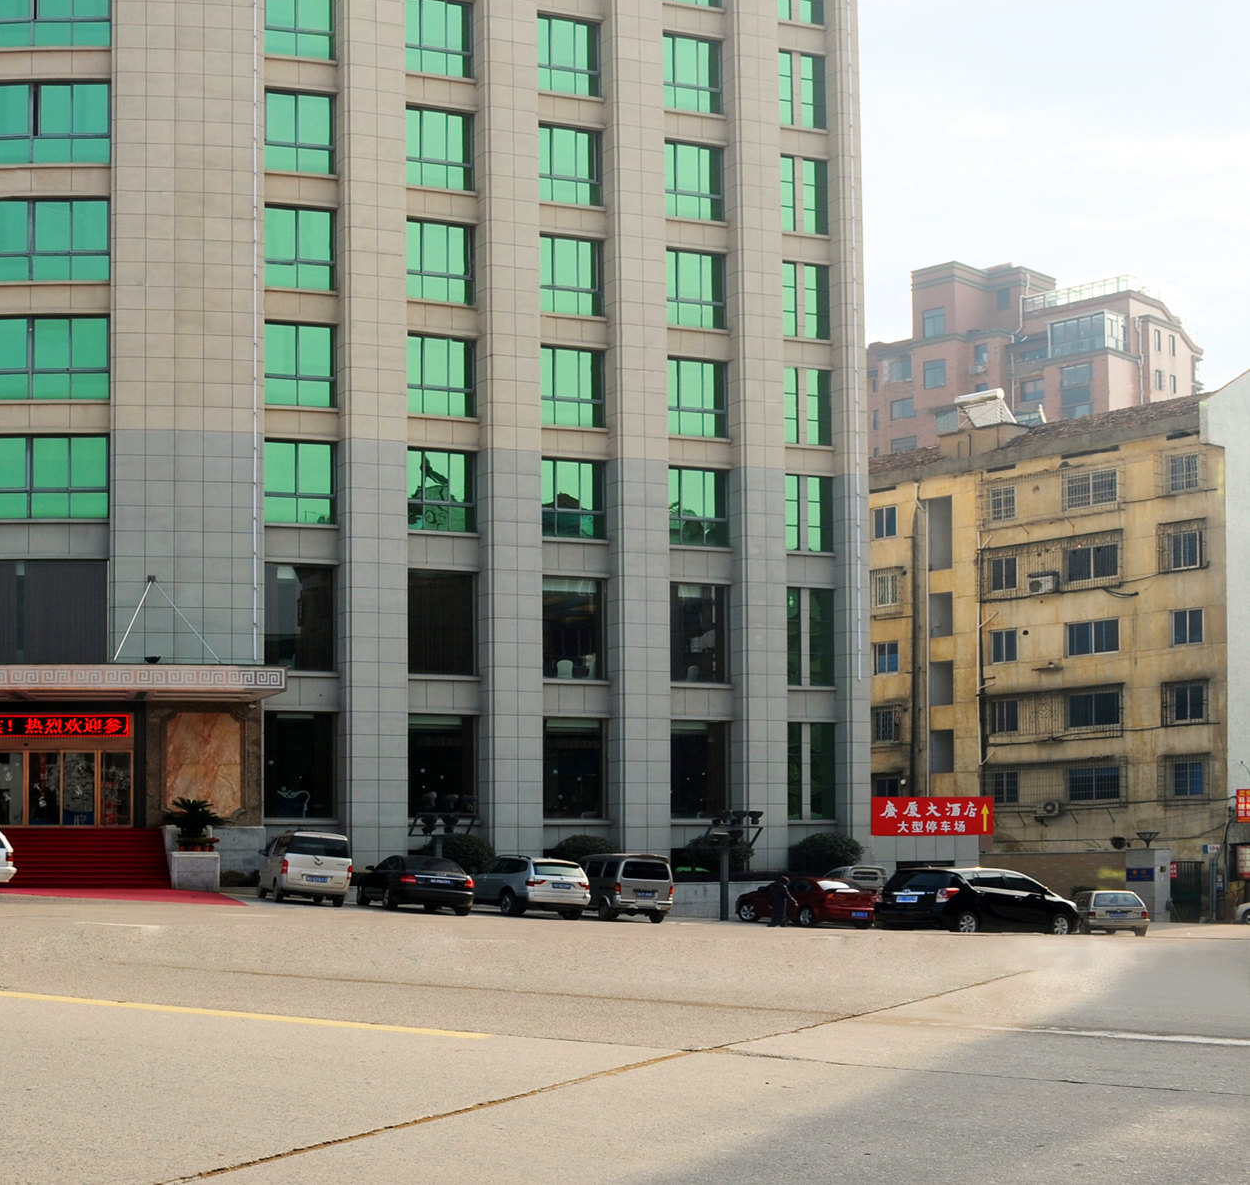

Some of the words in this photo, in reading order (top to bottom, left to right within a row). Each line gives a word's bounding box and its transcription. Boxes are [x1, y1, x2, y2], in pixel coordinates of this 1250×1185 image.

[897, 820, 966, 833] 大型停车场
